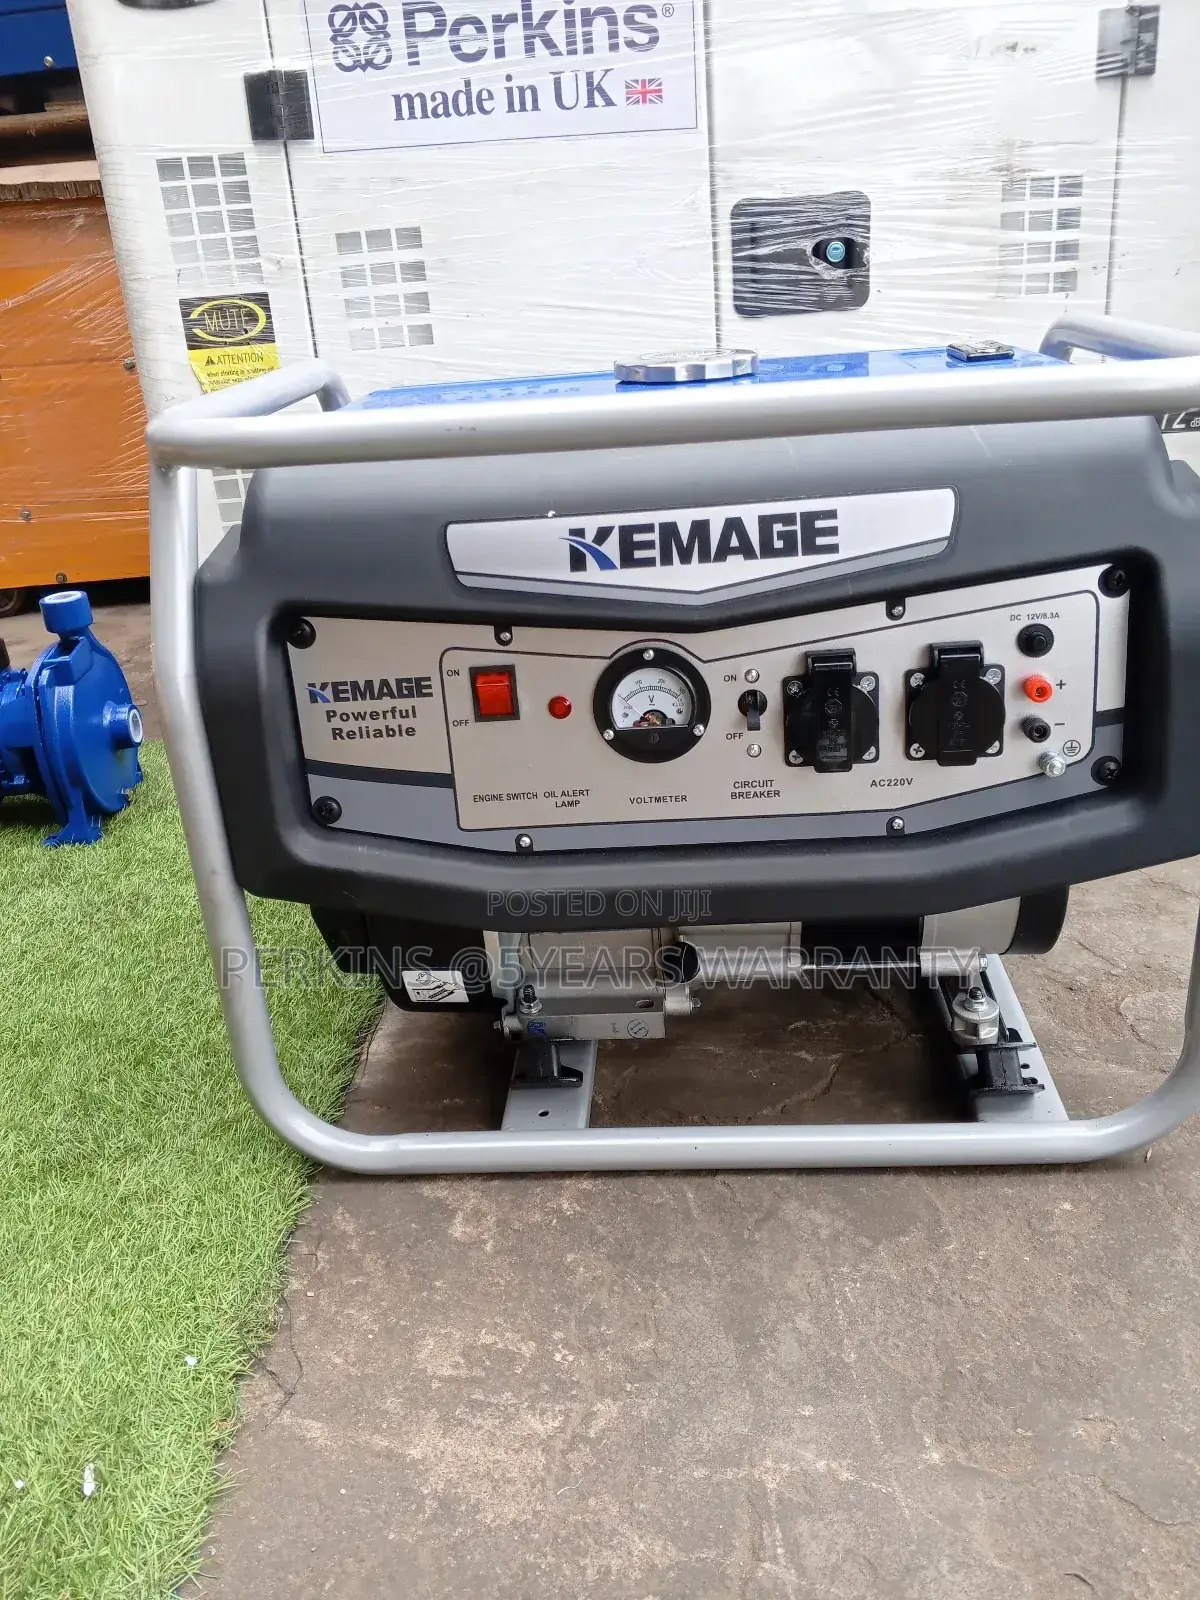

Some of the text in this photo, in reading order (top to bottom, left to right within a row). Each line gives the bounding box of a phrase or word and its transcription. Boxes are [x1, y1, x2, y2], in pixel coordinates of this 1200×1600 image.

[393, 68, 617, 121] made in UK
[204, 307, 250, 331] MUTE
[217, 352, 263, 365] ATTENTION
[559, 508, 839, 573] KEMAGE
[1026, 612, 1060, 621] 12V/8.3A
[446, 668, 460, 677] ON
[723, 674, 737, 682] ON
[305, 676, 434, 704] KEMAGE
[325, 705, 417, 723] Powerful
[452, 719, 470, 728] OFF
[331, 725, 417, 741] Reliable
[726, 732, 744, 740] OFF
[733, 779, 775, 789] CIRCUIT
[870, 777, 914, 788] AC220V
[473, 791, 538, 803] ENGINE SWITCH
[543, 788, 591, 798] OIL ALERT
[730, 789, 781, 800] BREAKER
[555, 799, 581, 808] LAMP
[629, 794, 688, 805] VOLTMETER
